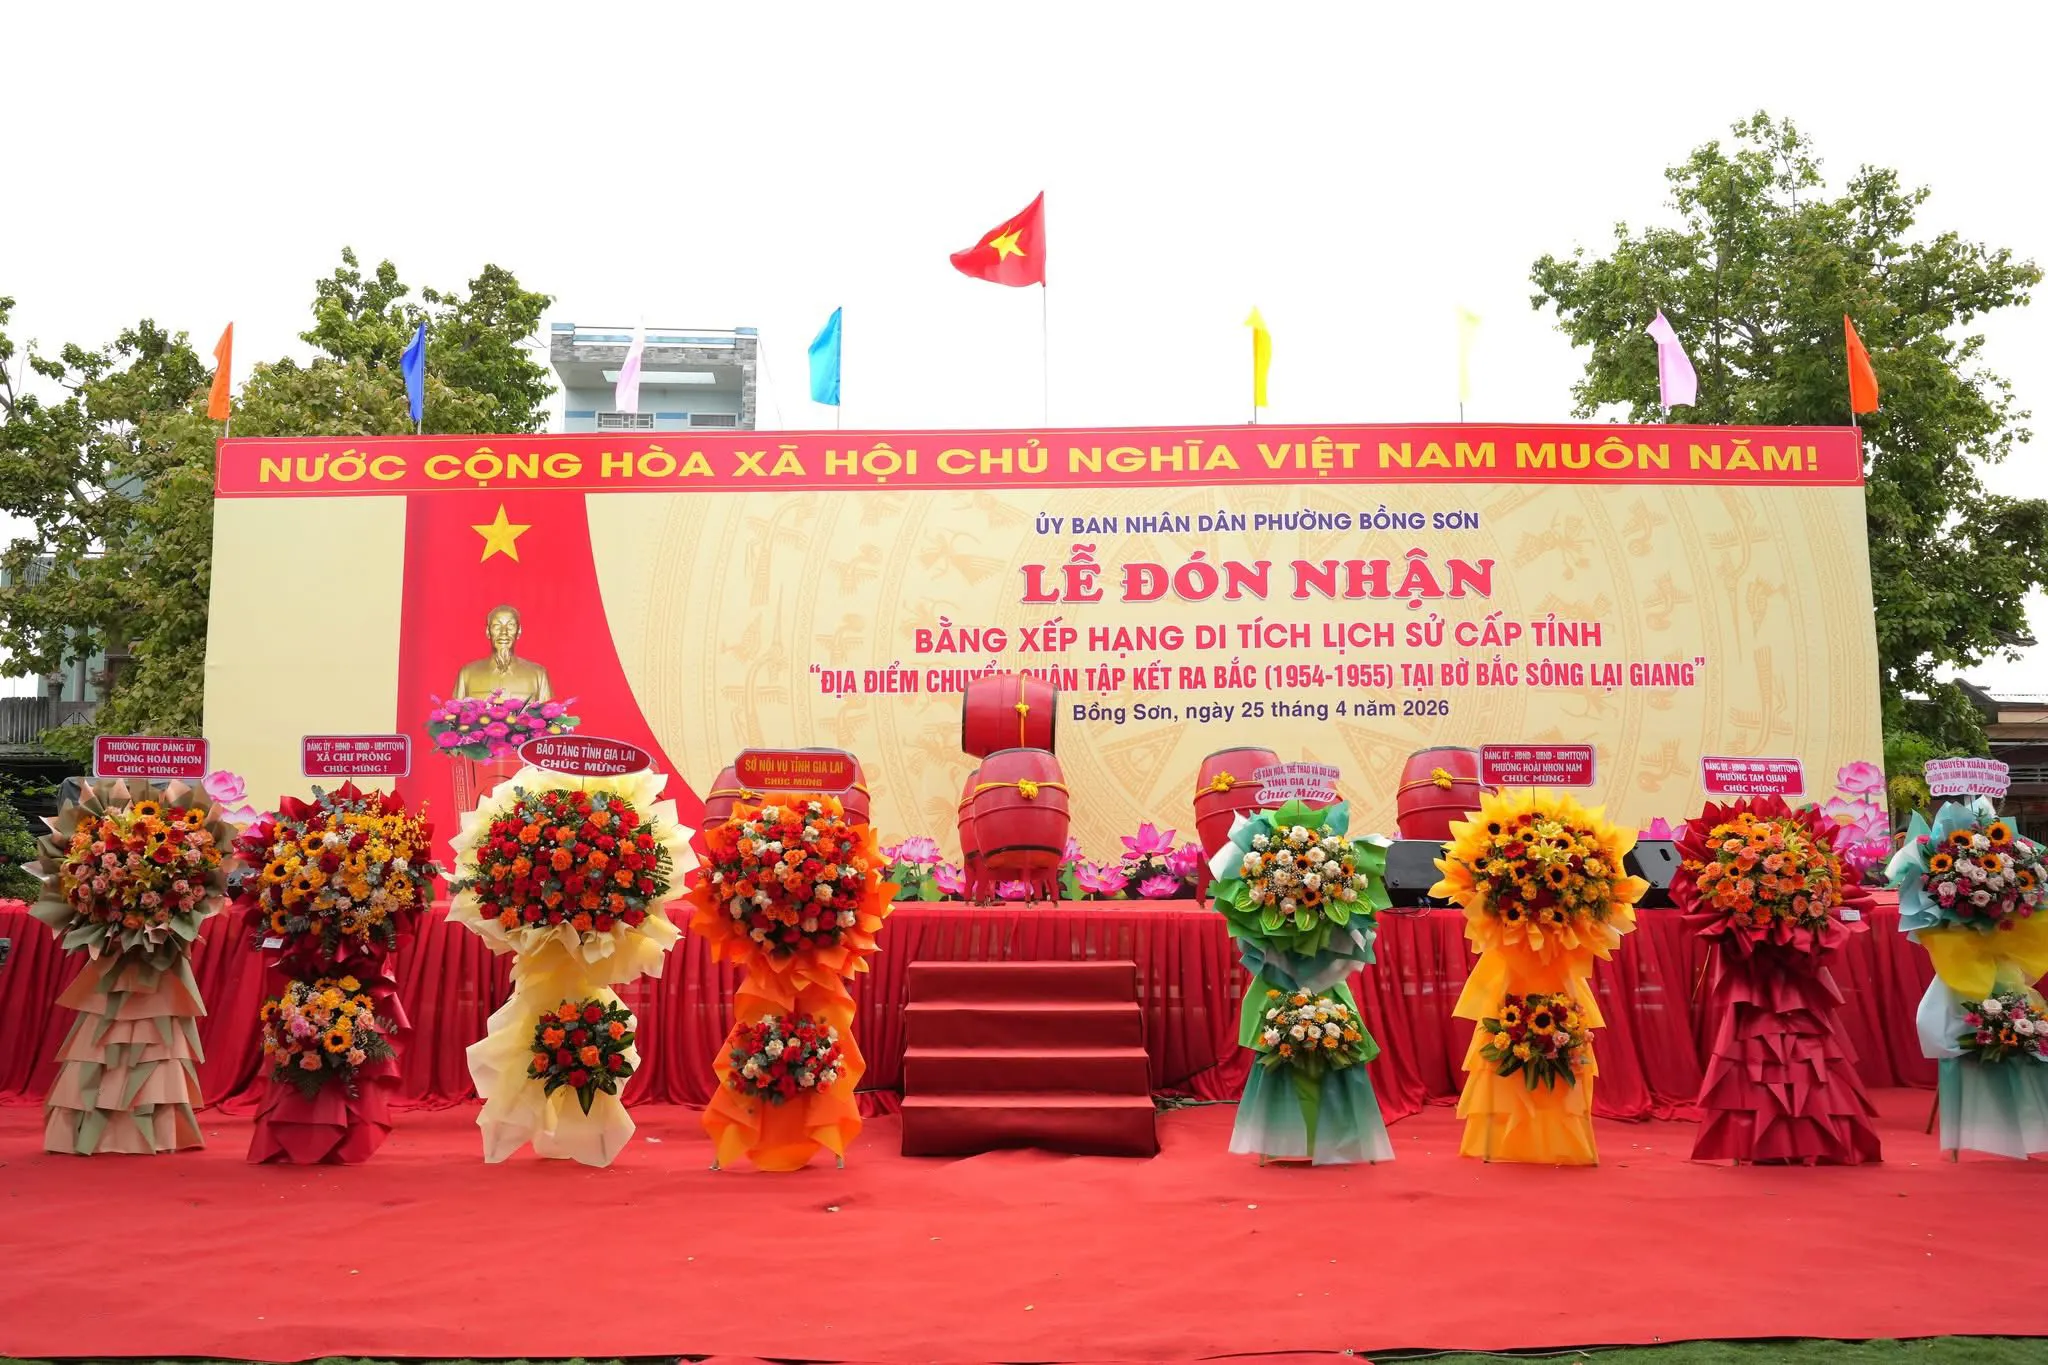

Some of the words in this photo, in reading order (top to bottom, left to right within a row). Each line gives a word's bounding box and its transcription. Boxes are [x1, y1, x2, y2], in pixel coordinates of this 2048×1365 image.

[259, 449, 407, 483] NƯỚC
[424, 446, 583, 487] CỘNG
[600, 445, 716, 478] HÒA
[732, 444, 807, 477] XÃ
[825, 443, 918, 483] HỘI
[936, 438, 1049, 475] CHỦ
[1069, 439, 1240, 473] NGHĨA
[1256, 435, 1361, 477] VIỆT
[1379, 442, 1496, 469] NAM
[1515, 436, 1671, 470] MUÔN
[1689, 438, 1818, 471] NĂM!
[1036, 511, 1064, 535] ỦY
[1072, 517, 1118, 534] BAN
[1125, 511, 1190, 533] NHÂN
[1198, 510, 1246, 532] DÂN
[1254, 508, 1352, 531] PHƯỜNG
[1359, 504, 1427, 530] BỒNG
[1433, 510, 1479, 529] SƠN
[1021, 543, 1104, 603] LỄ
[1121, 550, 1272, 602] ĐÓN
[1290, 547, 1496, 610] NHẬN
[915, 616, 1007, 653] BẰNG
[1019, 616, 1078, 652] XẾP
[1089, 625, 1184, 659] HẠNG
[1195, 625, 1226, 650] DI
[1238, 616, 1311, 649] TÍCH
[1323, 623, 1395, 655] LỊCH
[1406, 613, 1445, 647] SỬ
[1454, 611, 1522, 647] CẤP
[1531, 613, 1602, 647] TỈNH
[809, 664, 857, 699] “ĐỊA
[863, 660, 919, 693] ĐIỂM
[1085, 662, 1125, 696] TẬP
[1133, 659, 1172, 691] KẾT
[1180, 666, 1207, 690] RA
[1213, 657, 1257, 689] BẮC
[1264, 664, 1393, 690] (1954-1955)
[1400, 664, 1434, 692] TẠI
[1441, 658, 1470, 686] BỜ
[1476, 654, 1519, 687] BẮC
[1526, 659, 1584, 687] SÔNG
[1590, 663, 1623, 692] LẠI
[1629, 657, 1706, 687] GIANG”
[1073, 701, 1126, 725] Bồng
[1133, 703, 1179, 724] Sơn,
[1186, 701, 1236, 722] ngày
[1241, 702, 1265, 718] 25
[1271, 700, 1329, 721] tháng
[1335, 701, 1348, 717] 4
[1354, 699, 1396, 717] năm
[1403, 700, 1449, 716] 2026
[107, 740, 140, 751] THƯỜNG
[163, 741, 184, 752] ĐẢNG
[536, 739, 554, 755] BẢO
[581, 743, 601, 759] TỈNH
[603, 748, 618, 761] GIA
[620, 749, 636, 762] LAI
[103, 752, 144, 763] PHƯỜNG
[147, 753, 170, 763] HOÀI
[173, 755, 201, 764] NHƠN
[316, 751, 330, 762] XÃ
[117, 764, 145, 773] CHÚC
[147, 765, 178, 774] MỪNG
[323, 763, 350, 773] CHÚC
[352, 764, 381, 772] MỪNG
[540, 758, 579, 769] CHÚC
[584, 761, 627, 773] MỪNG
[776, 760, 788, 775] VỤ
[791, 756, 810, 773] TỈNH
[812, 760, 828, 774] GIA
[829, 761, 843, 774] LAI
[1491, 761, 1522, 772] PHƯỜNG
[1523, 761, 1541, 772] HOÀI
[1542, 762, 1564, 772] NHƠN
[1565, 763, 1582, 772] NAM
[1966, 759, 1986, 769] XUÂN
[1267, 777, 1287, 788] TỈNH
[1290, 777, 1305, 786] GIA
[1307, 778, 1321, 787] LAI
[1501, 773, 1530, 783] CHÚC
[1532, 773, 1565, 783] MỪNG
[1716, 772, 1748, 782] PHƯỜNG
[1748, 773, 1765, 782] TAM
[1765, 774, 1787, 783] QUAN
[1258, 788, 1292, 801] Chúc
[1294, 787, 1335, 800] Mừng
[1723, 783, 1749, 792] CHÚC
[1932, 782, 1963, 794] Chúc
[1966, 783, 2005, 797] Mừng
